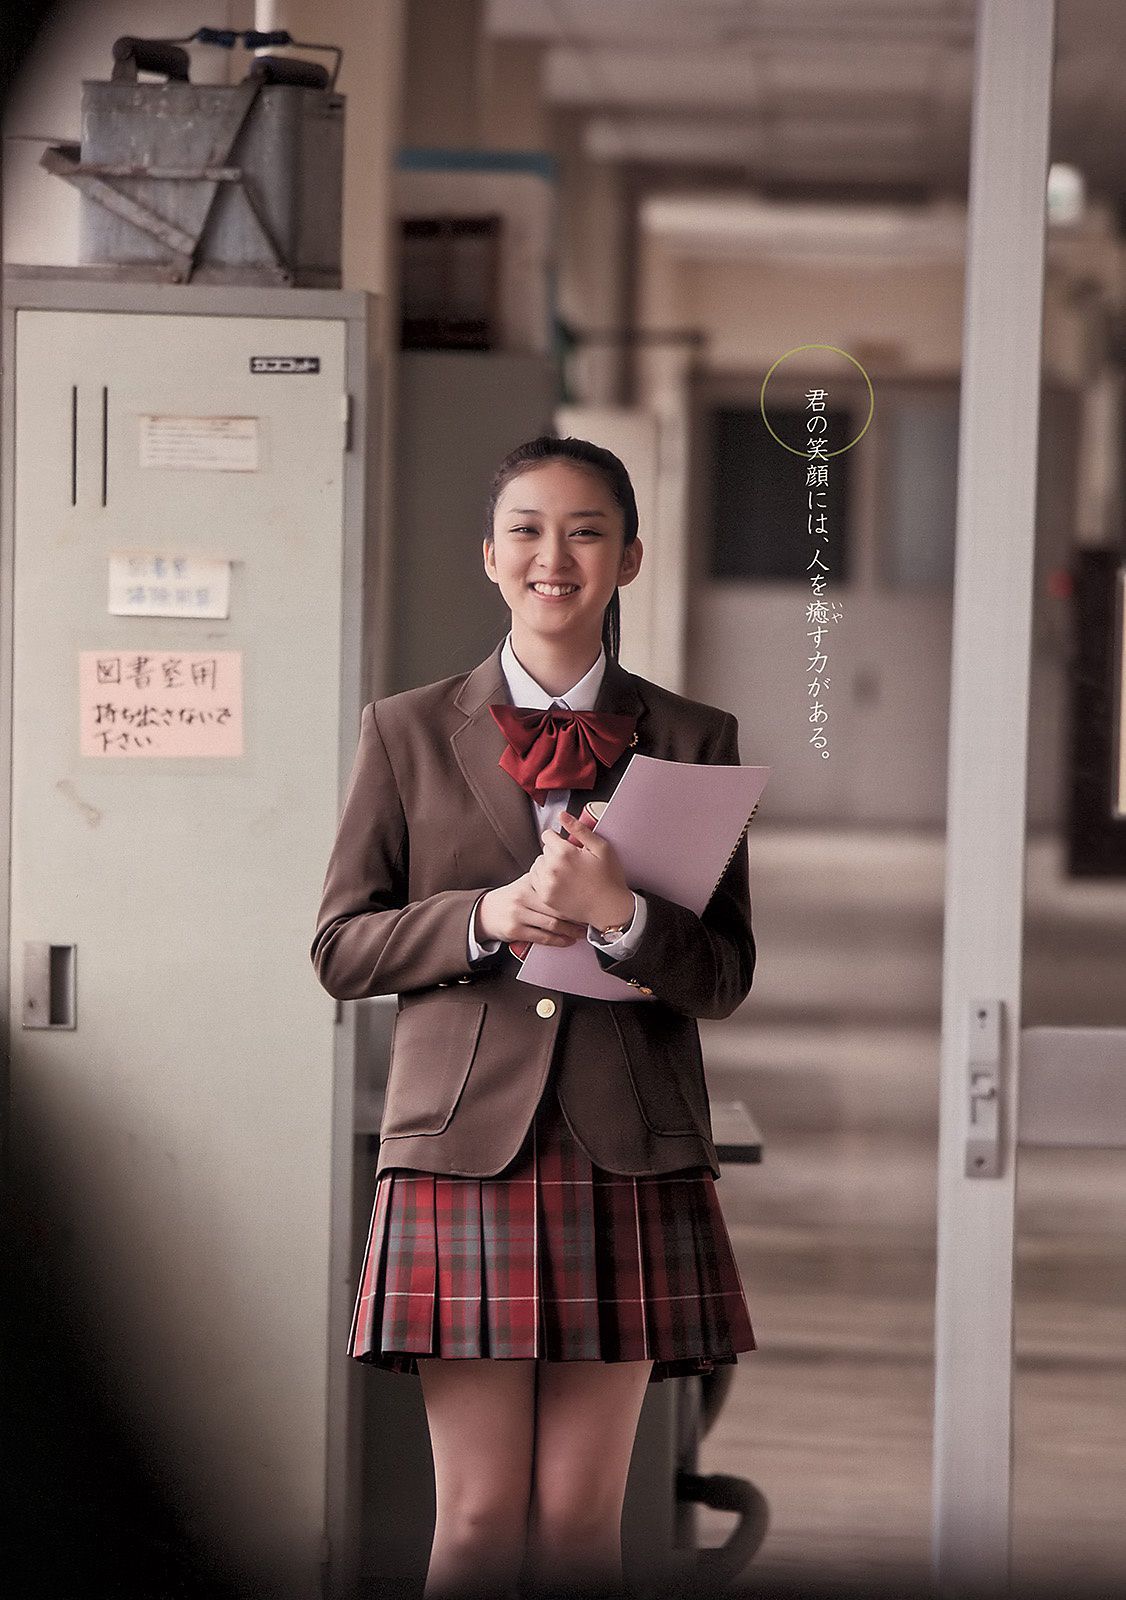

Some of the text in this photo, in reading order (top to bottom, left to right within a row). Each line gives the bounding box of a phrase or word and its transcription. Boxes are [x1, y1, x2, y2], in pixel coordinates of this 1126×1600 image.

[96, 656, 217, 690] 図書室用
[94, 703, 233, 728] 持ち出さないで
